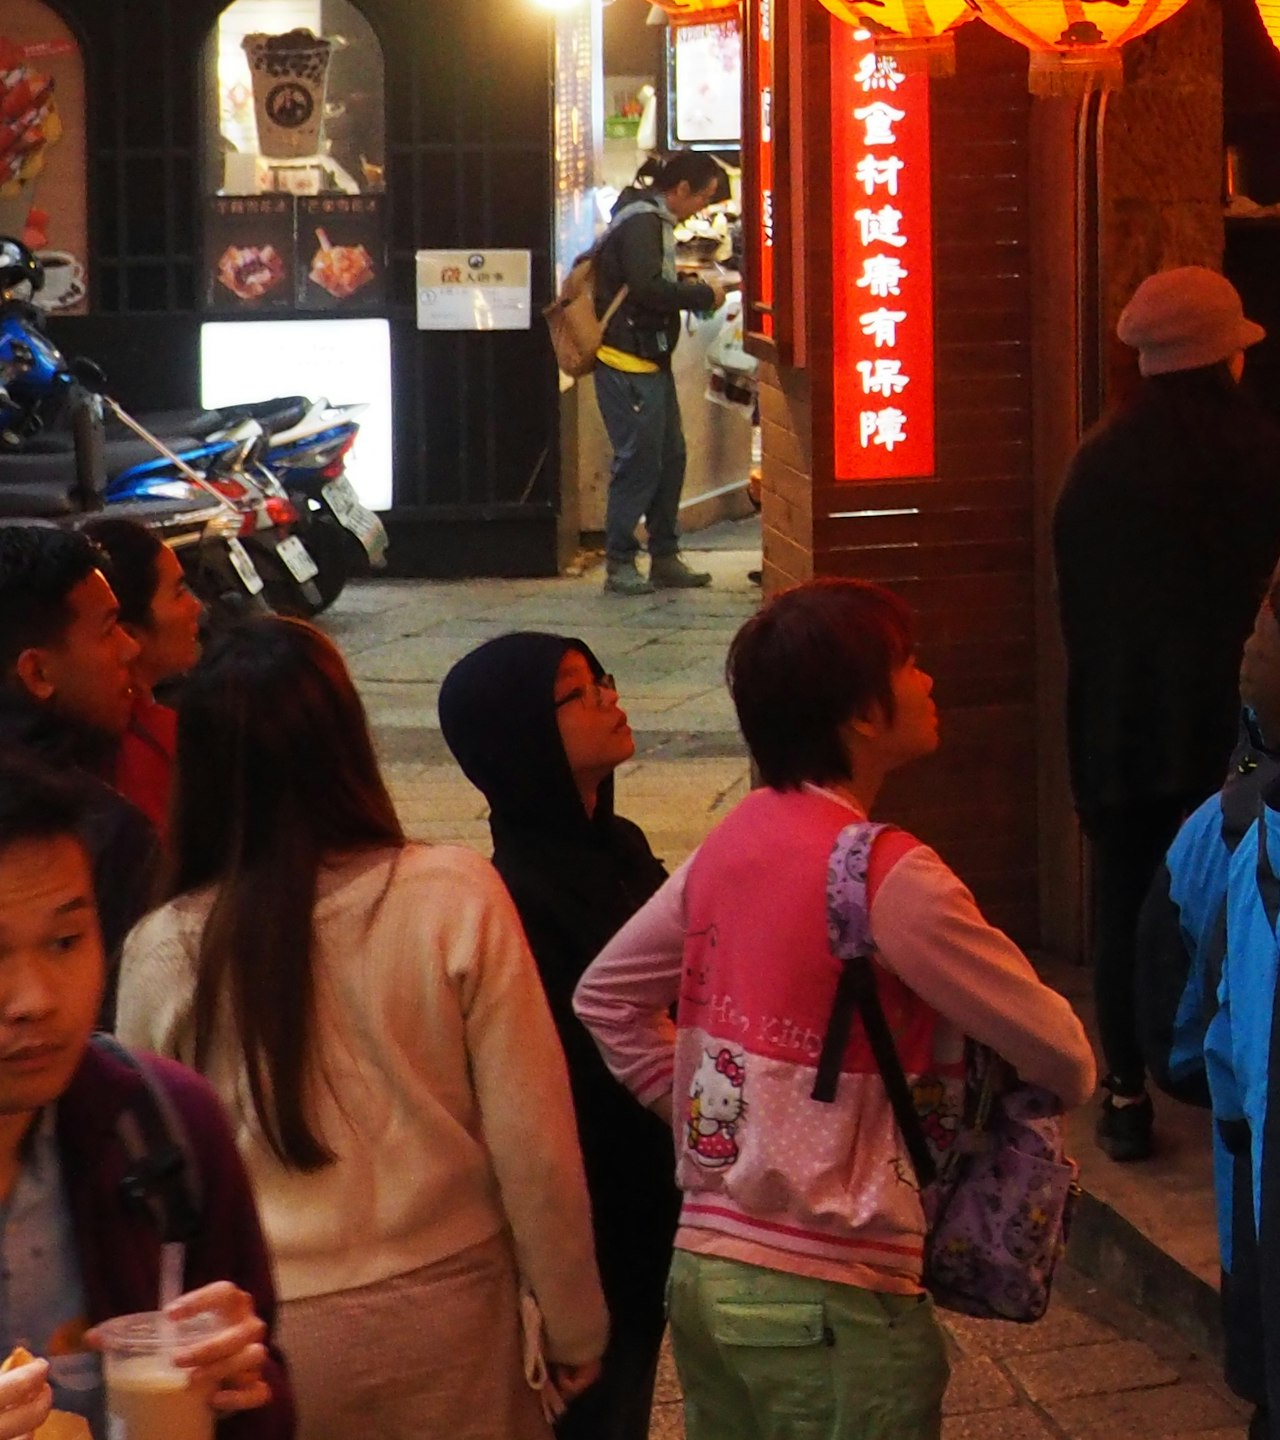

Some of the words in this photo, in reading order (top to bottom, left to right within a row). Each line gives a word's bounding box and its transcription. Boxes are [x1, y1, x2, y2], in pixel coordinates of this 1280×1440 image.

[854, 29, 910, 453] 然食材健康有保障
